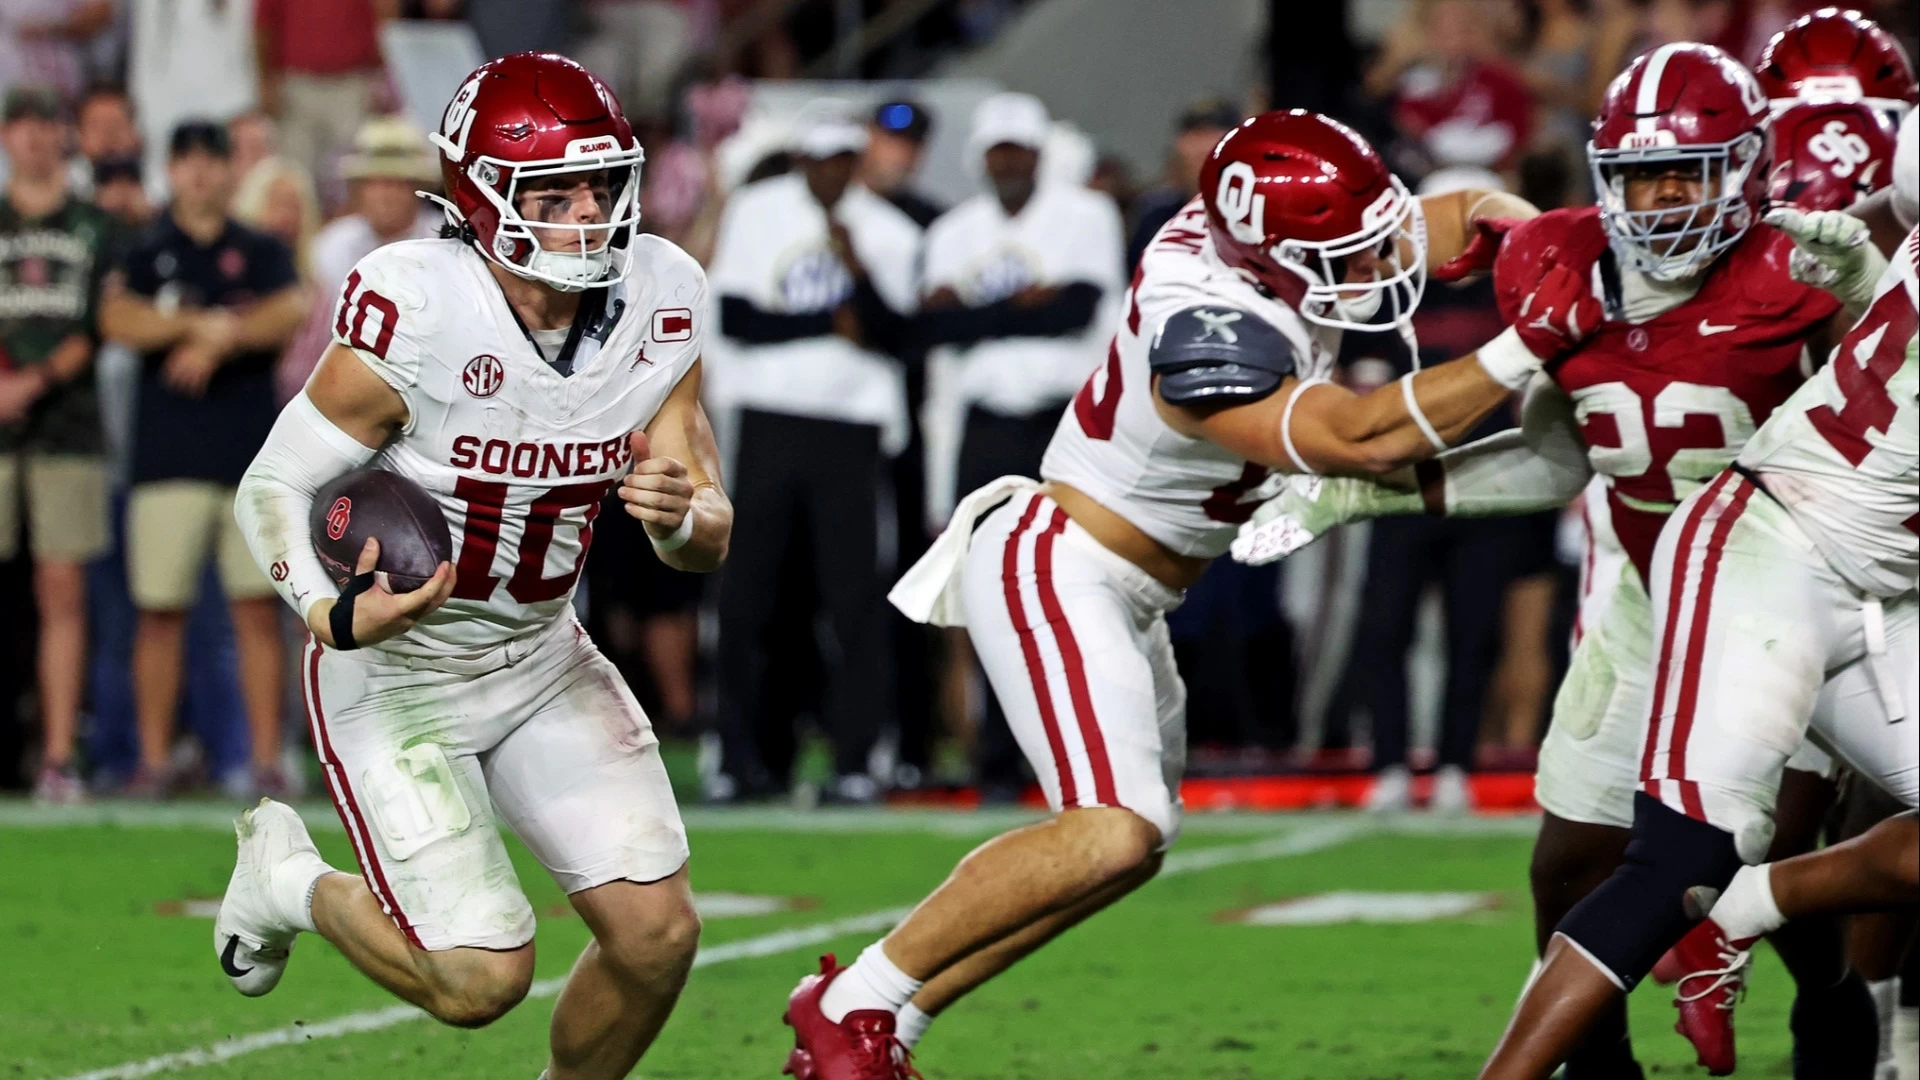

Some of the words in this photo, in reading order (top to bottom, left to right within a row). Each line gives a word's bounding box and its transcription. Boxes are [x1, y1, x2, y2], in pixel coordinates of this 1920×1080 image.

[579, 141, 613, 153] OKLAHOMA
[1808, 120, 1871, 178] 96
[1216, 161, 1266, 244] OU
[336, 268, 399, 360] 10
[463, 355, 504, 398] SEC
[1571, 381, 1758, 501] 22
[450, 475, 616, 604] 10
